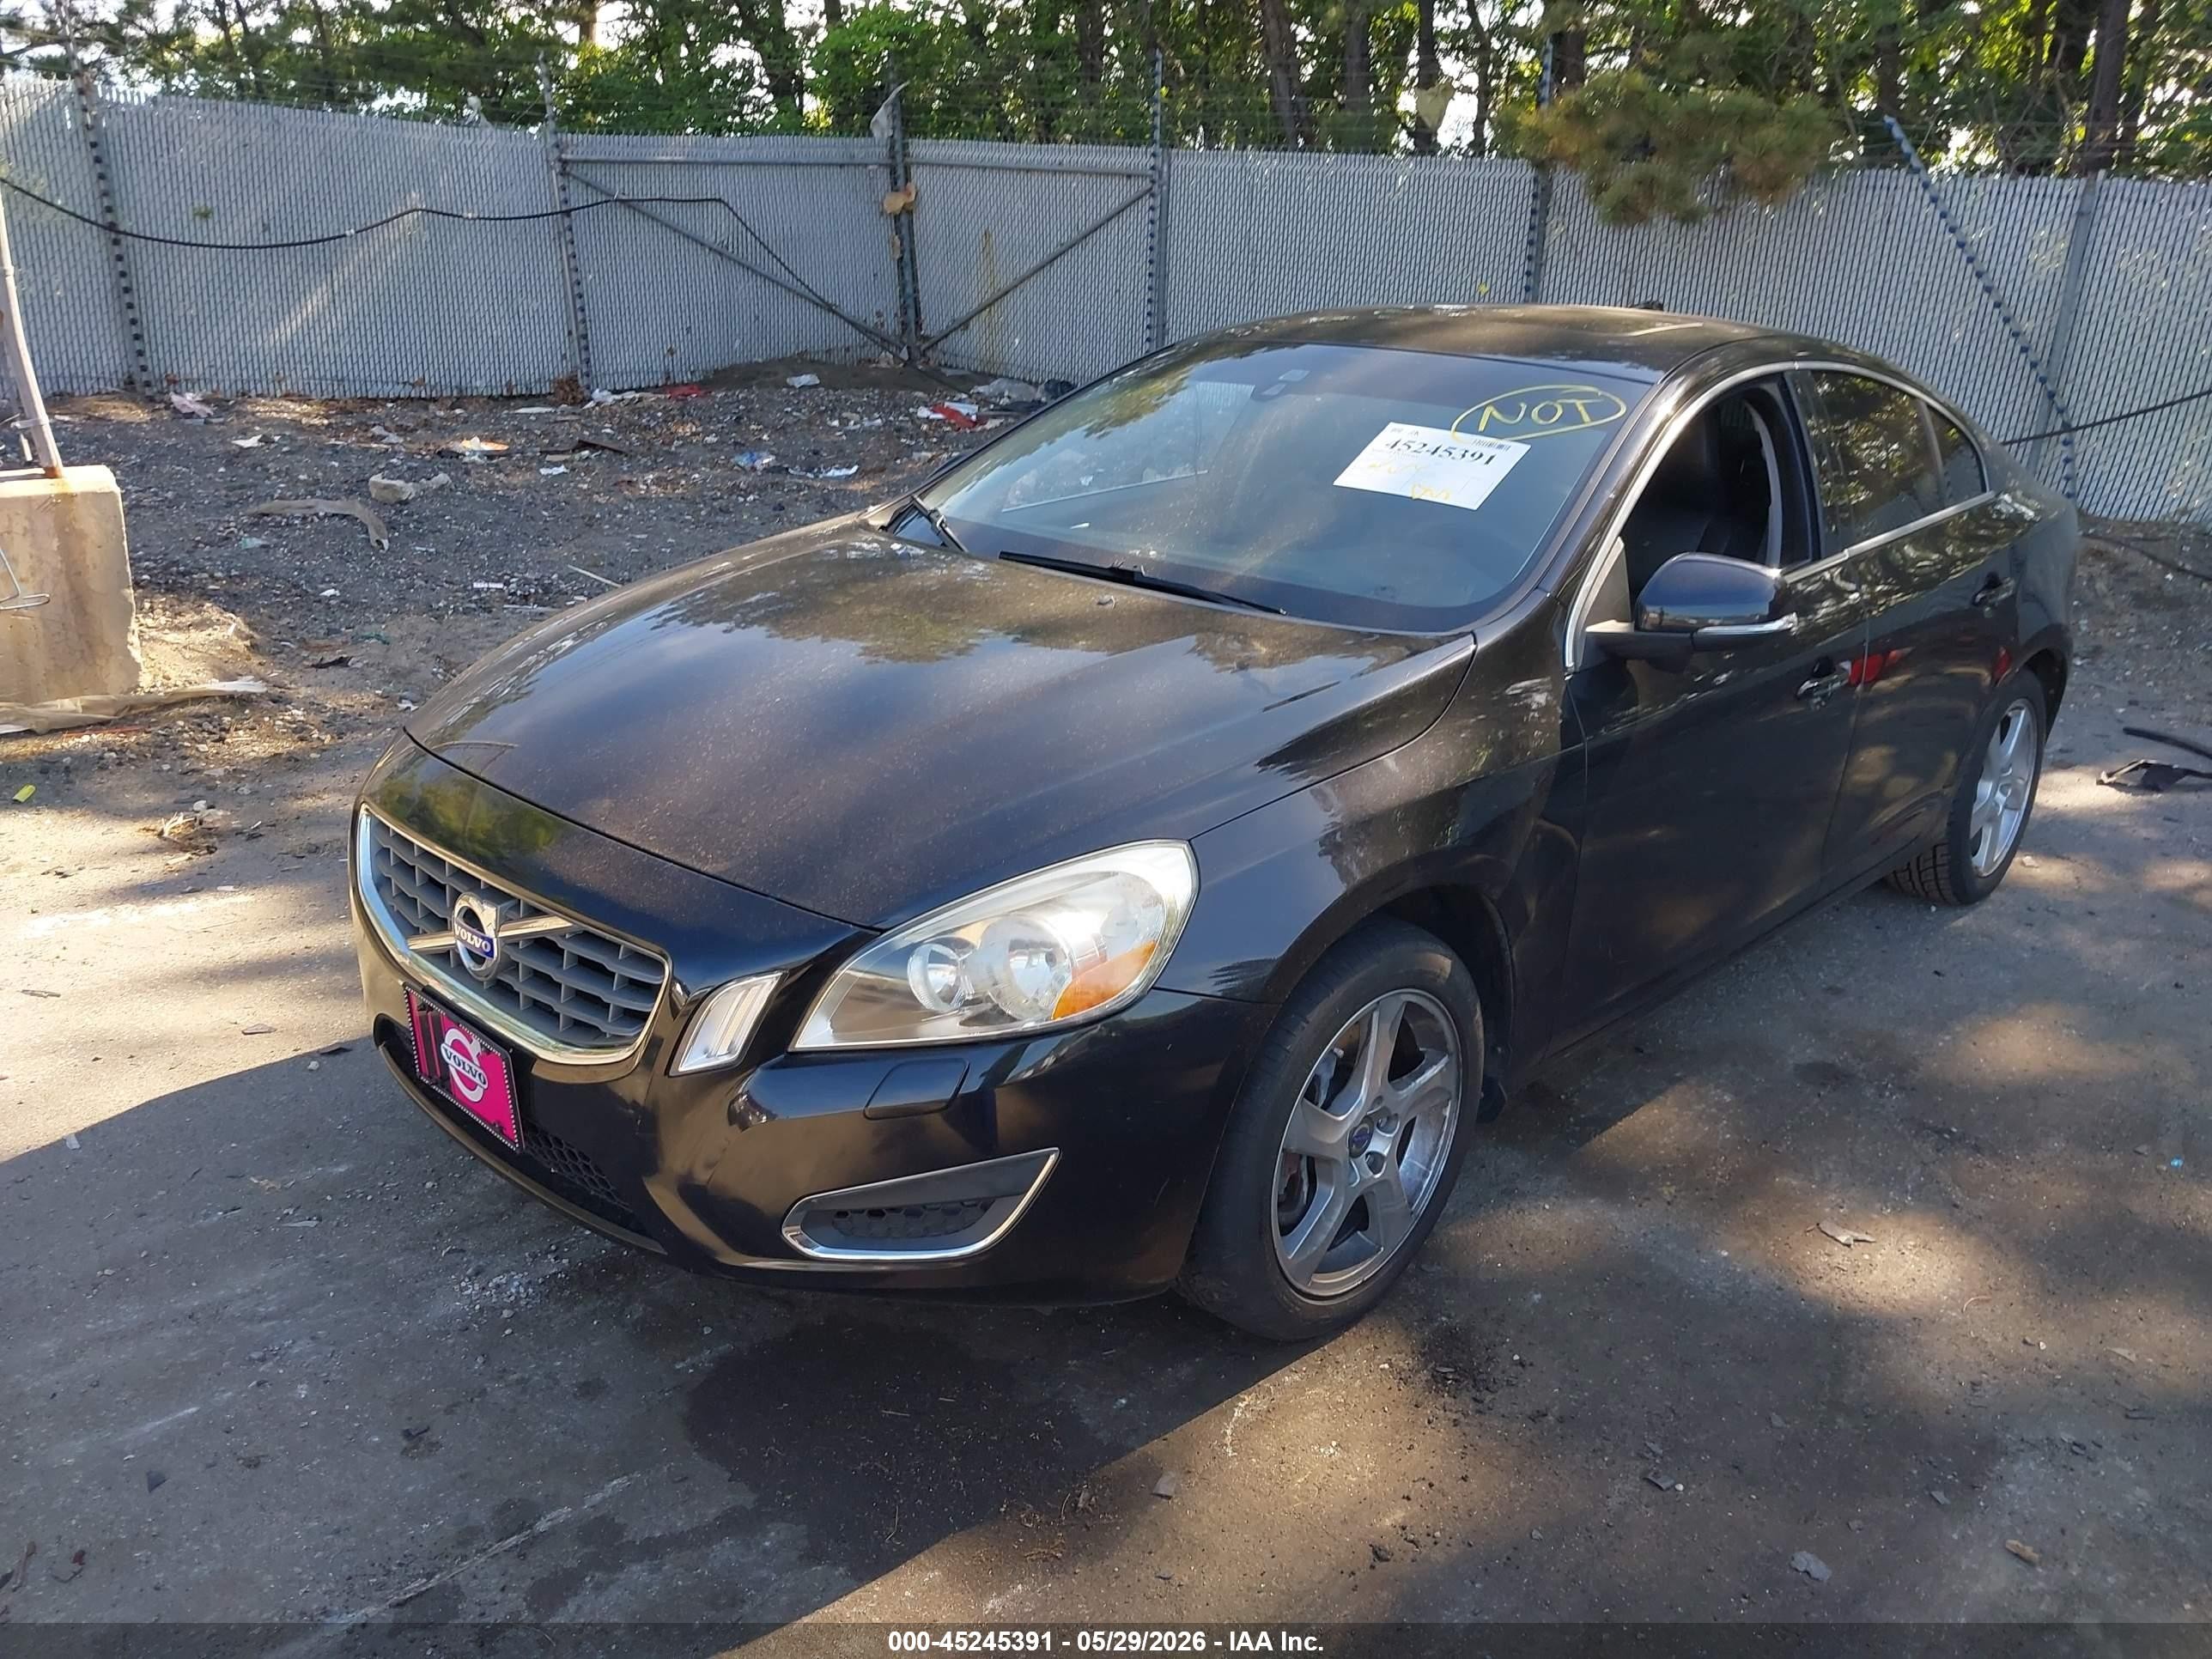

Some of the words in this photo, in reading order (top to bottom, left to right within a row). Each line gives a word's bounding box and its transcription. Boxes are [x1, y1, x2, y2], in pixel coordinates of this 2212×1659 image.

[1478, 398, 1605, 433] NOT
[1385, 438, 1498, 465] 45245391
[454, 924, 491, 952] VOLVO
[442, 1045, 487, 1085] VOLVO
